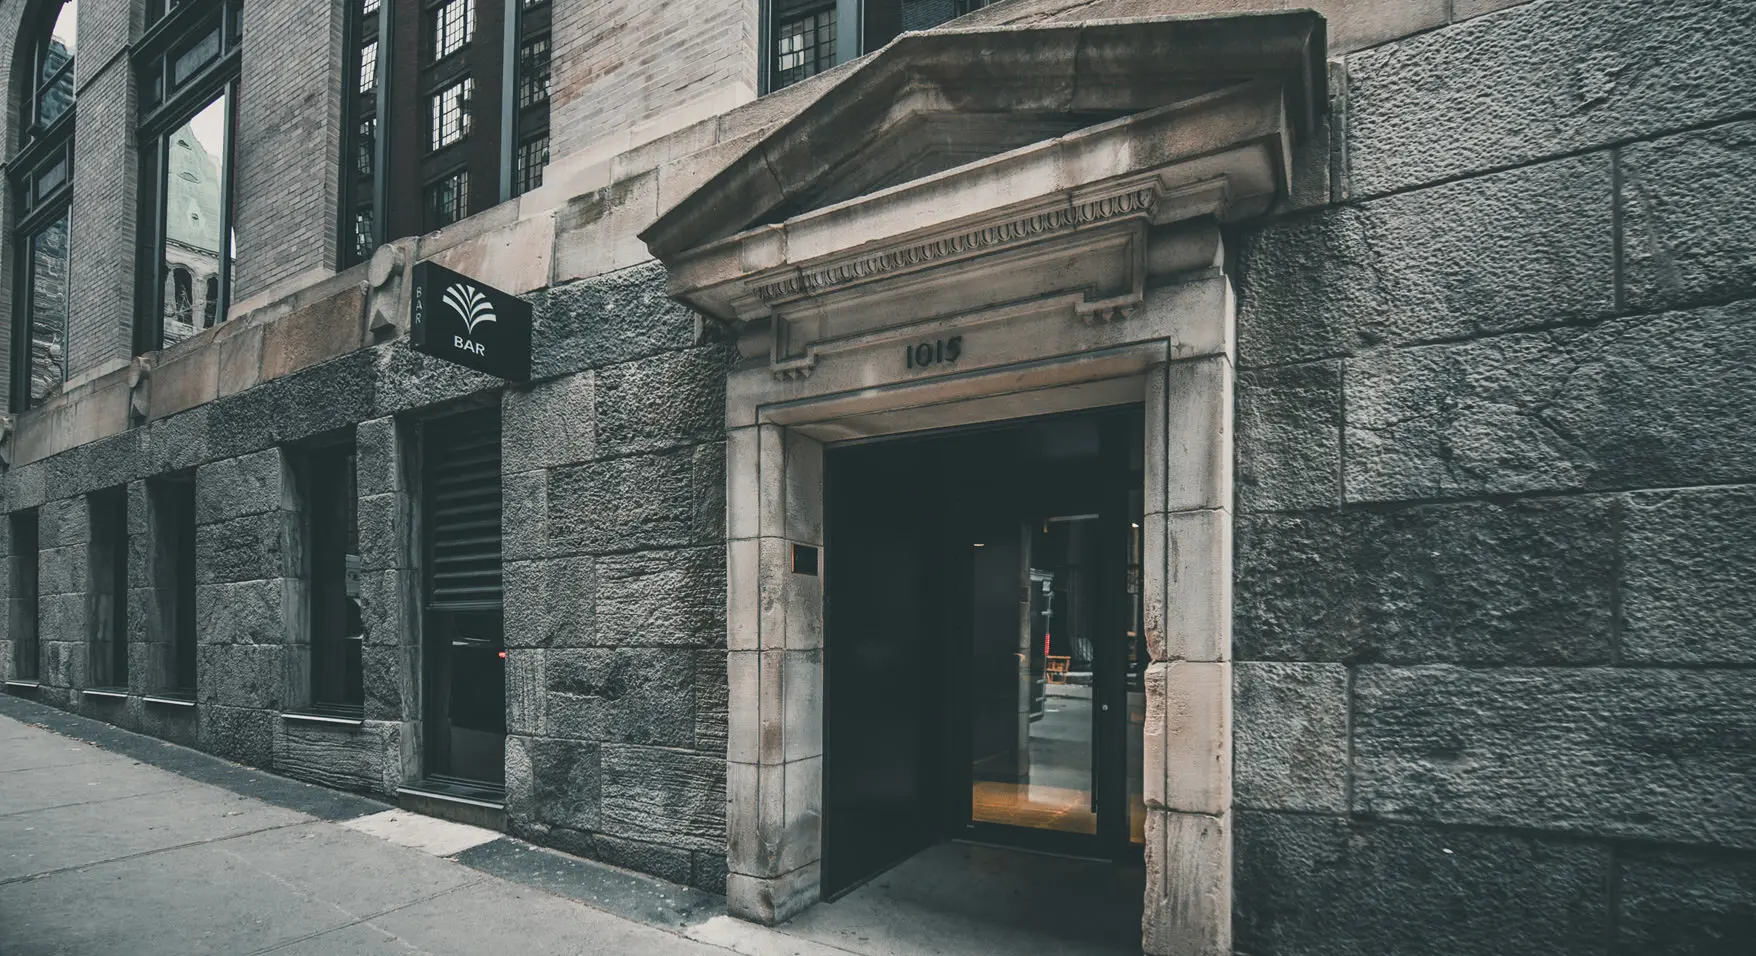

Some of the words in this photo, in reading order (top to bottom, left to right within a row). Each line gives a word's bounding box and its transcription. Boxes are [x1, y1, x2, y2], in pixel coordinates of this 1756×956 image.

[415, 286, 423, 324] BAR
[453, 335, 486, 357] BAR
[907, 336, 962, 368] 1015
